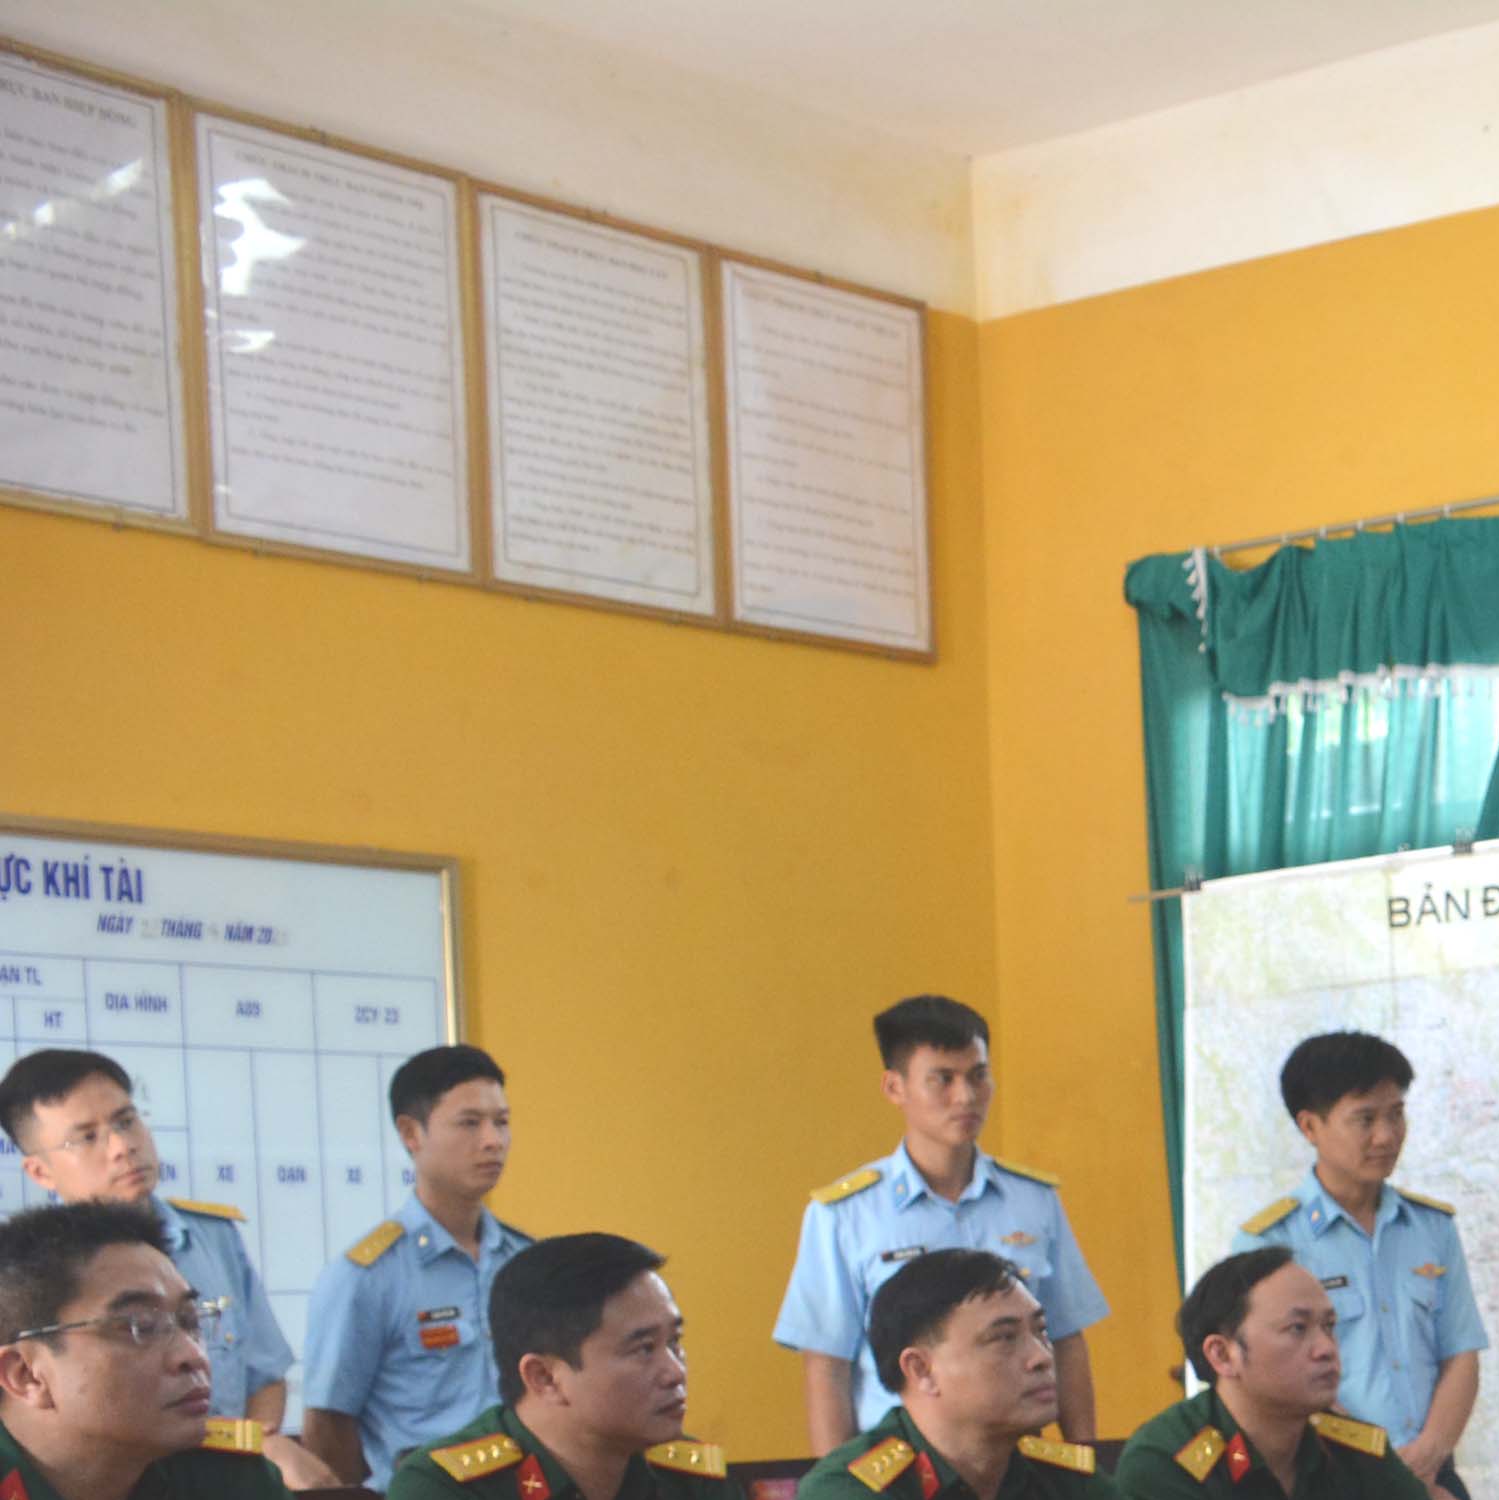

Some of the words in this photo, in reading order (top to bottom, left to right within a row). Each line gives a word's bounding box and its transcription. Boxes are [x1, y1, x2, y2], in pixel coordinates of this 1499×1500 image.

[42, 854, 91, 900] KHÍ
[99, 857, 144, 904] TÀI
[1387, 881, 1471, 929] BẢN
